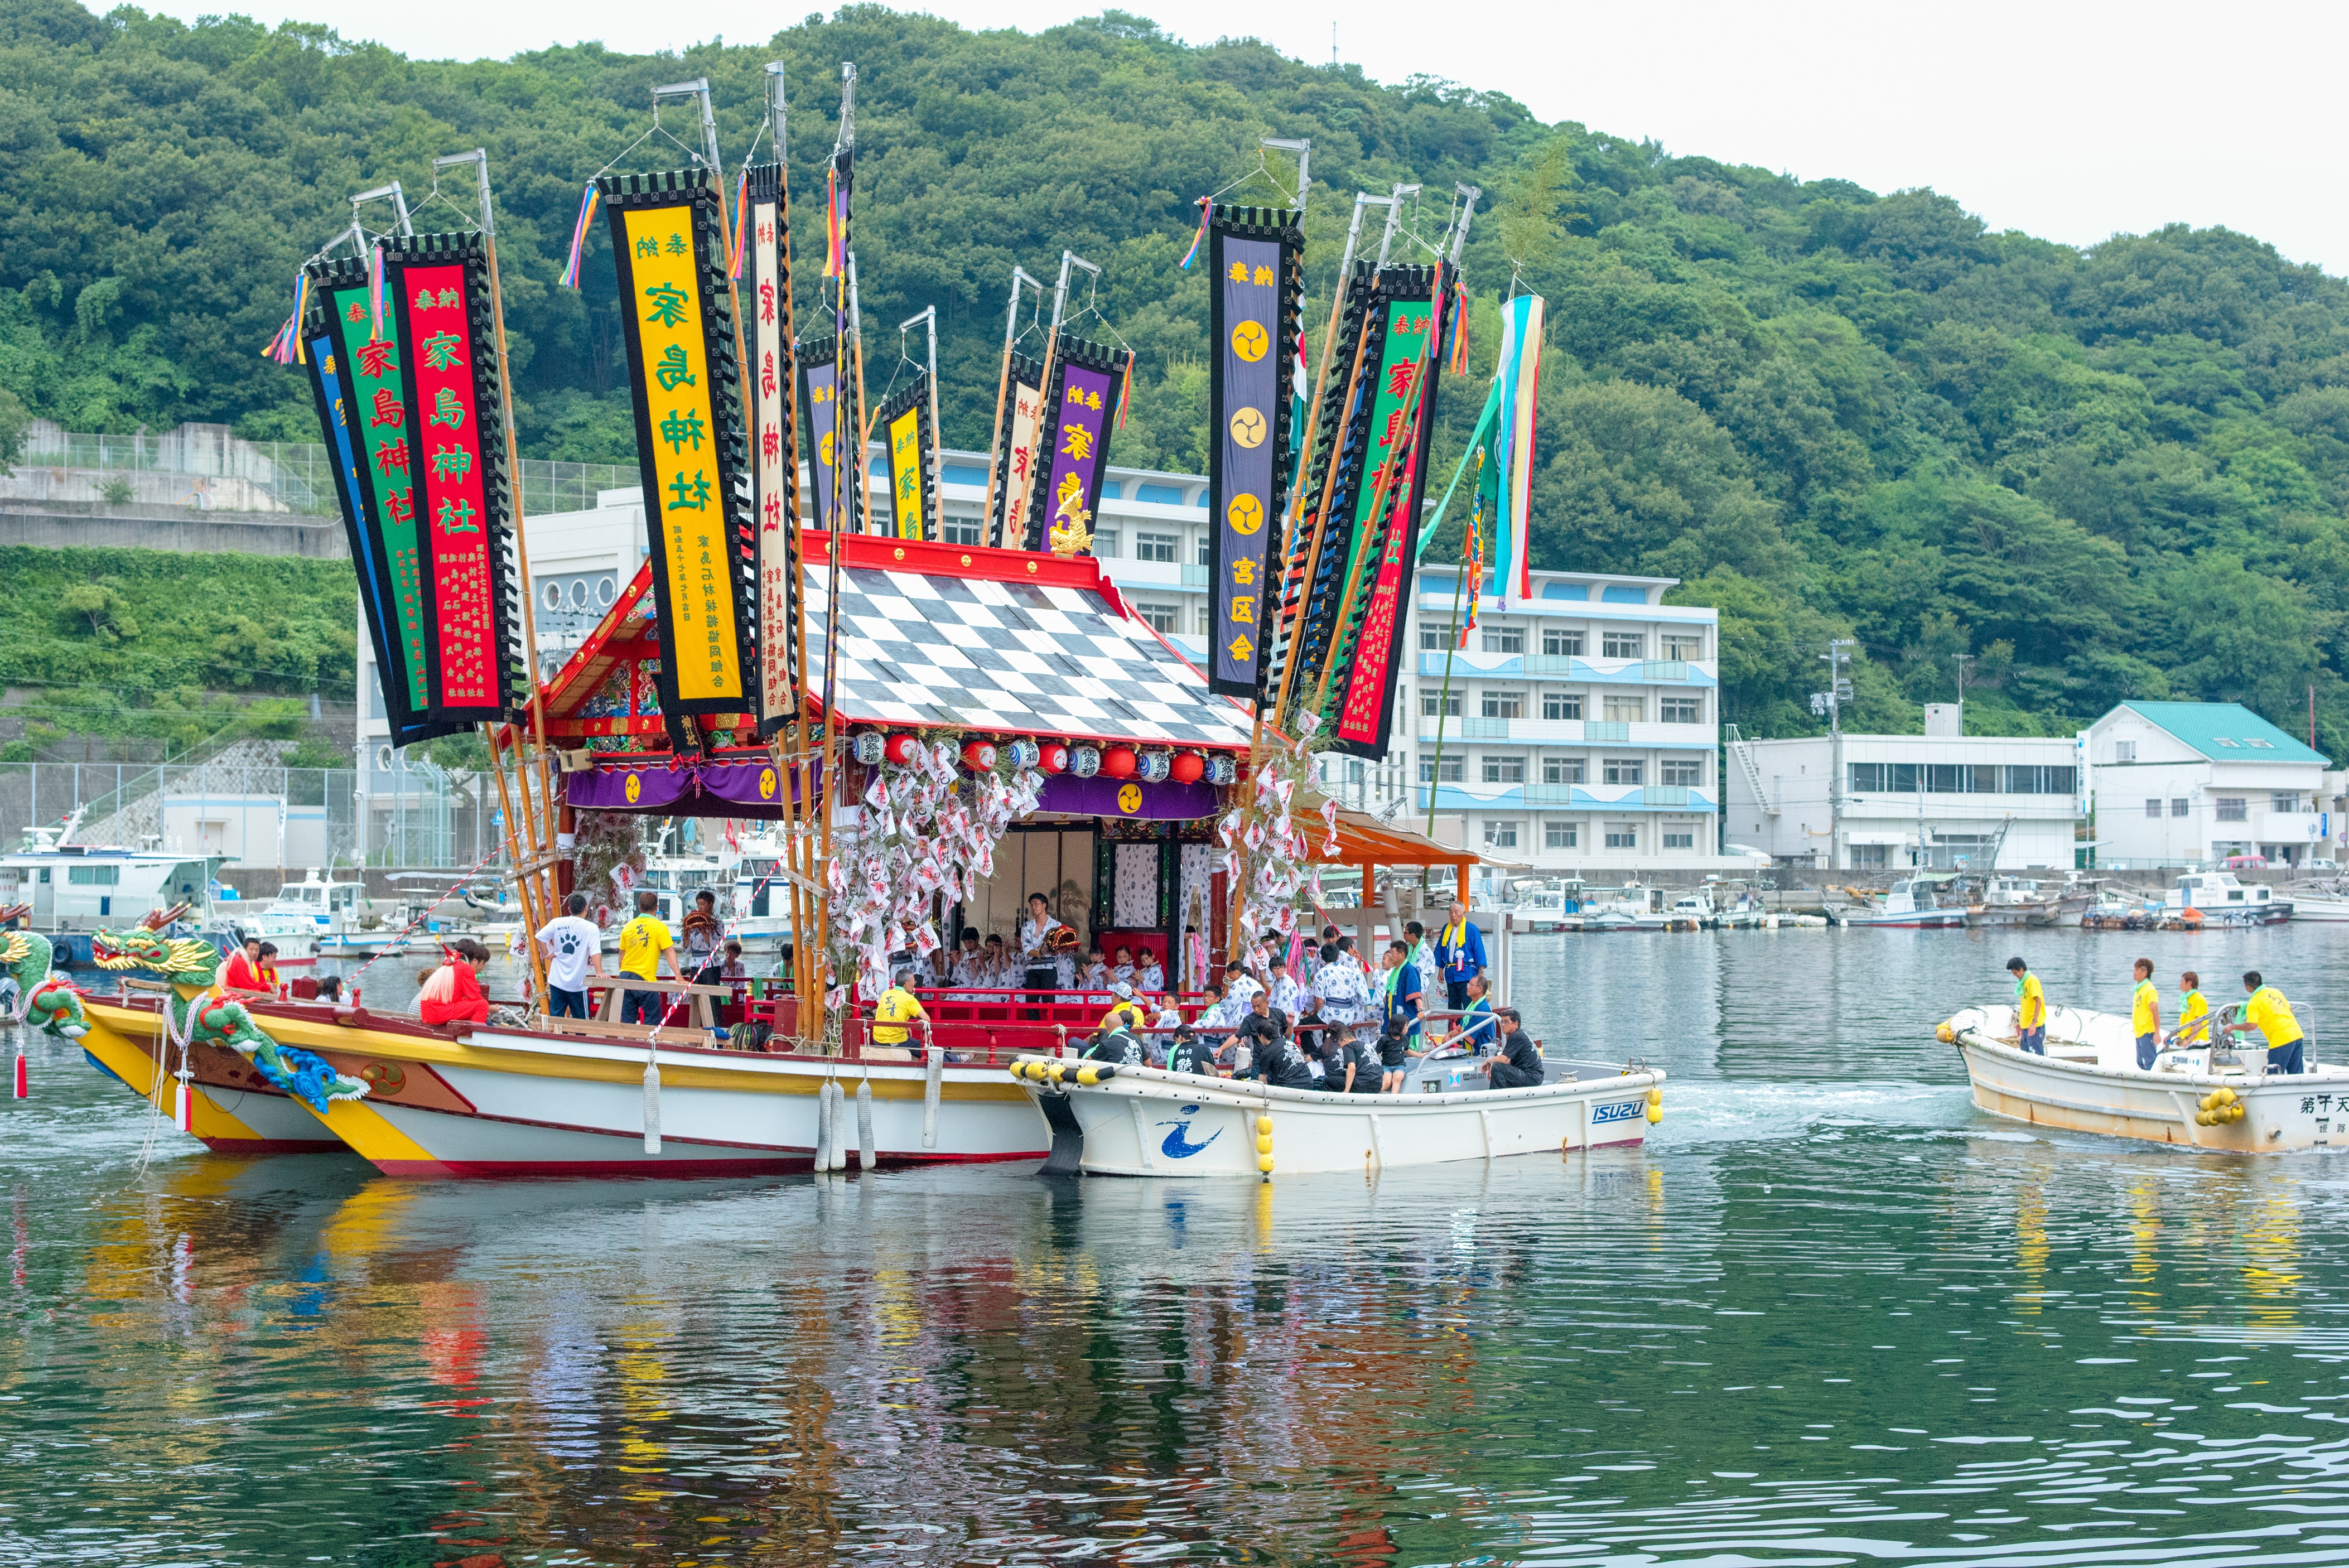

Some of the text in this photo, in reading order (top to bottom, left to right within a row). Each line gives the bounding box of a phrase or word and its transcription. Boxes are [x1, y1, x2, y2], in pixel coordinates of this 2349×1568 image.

[1228, 260, 1274, 287] 奉納
[414, 287, 460, 311] 奉納
[1392, 314, 1430, 336] 奉納
[356, 338, 415, 526] 家島神社
[422, 331, 480, 535] 家島神社
[895, 428, 915, 454] 奉納
[1228, 557, 1256, 662] 宮区会
[1081, 748, 1097, 776] 御祭禮
[1152, 752, 1168, 779] 御祭禮
[1593, 1102, 1643, 1121] ISUZU
